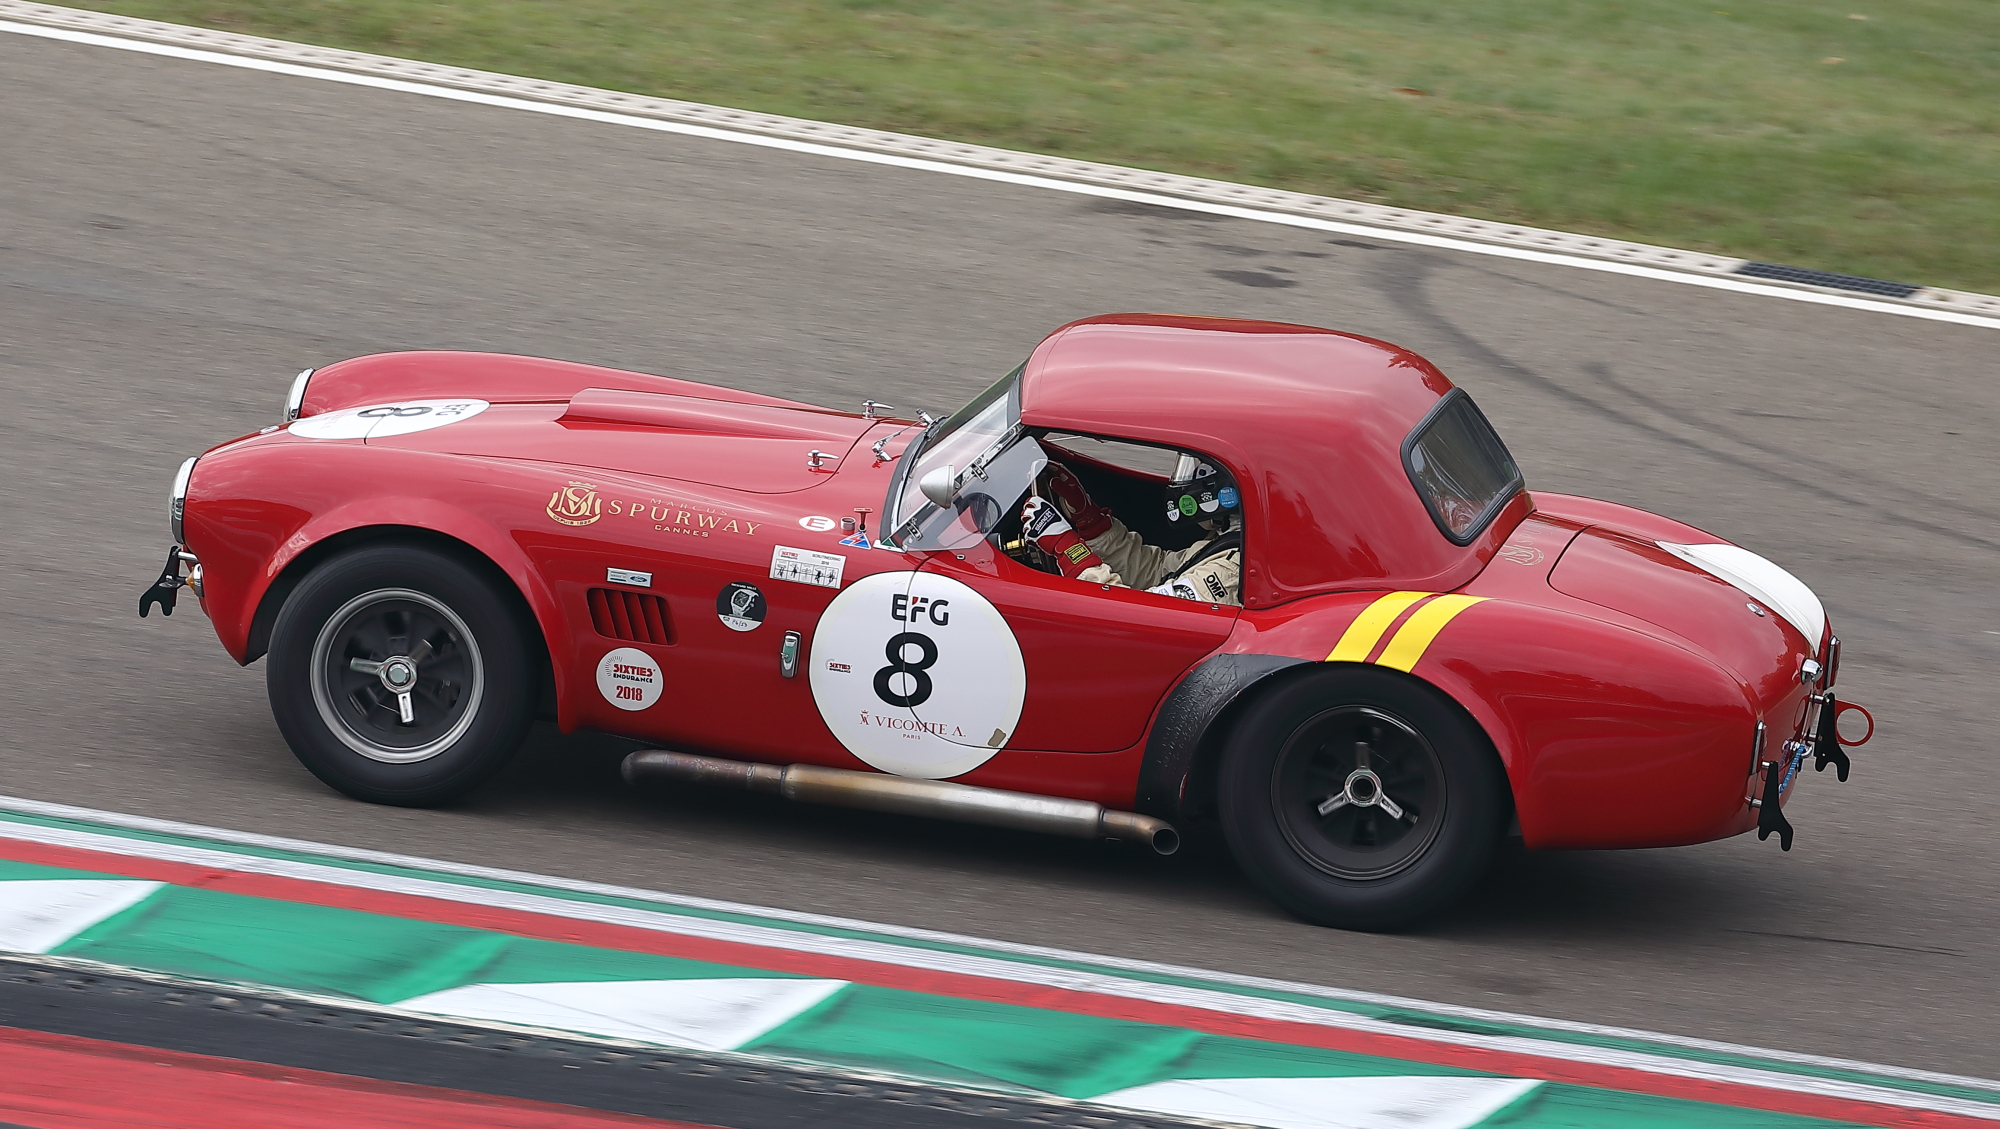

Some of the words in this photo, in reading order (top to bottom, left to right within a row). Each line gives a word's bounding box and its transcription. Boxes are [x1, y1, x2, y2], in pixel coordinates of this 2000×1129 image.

[650, 497, 729, 516] MARCUS
[607, 499, 762, 536] SPURWAY
[806, 517, 828, 530] E
[654, 524, 709, 538] CANNES
[1206, 574, 1225, 598] OMP
[891, 593, 949, 626] EFG
[612, 663, 656, 678] SIXTIES
[612, 672, 653, 684] ENDURANCE
[873, 632, 939, 708] 8
[615, 685, 643, 702] 2018
[874, 715, 948, 736] VICOMTE
[902, 733, 921, 741] PARIS
